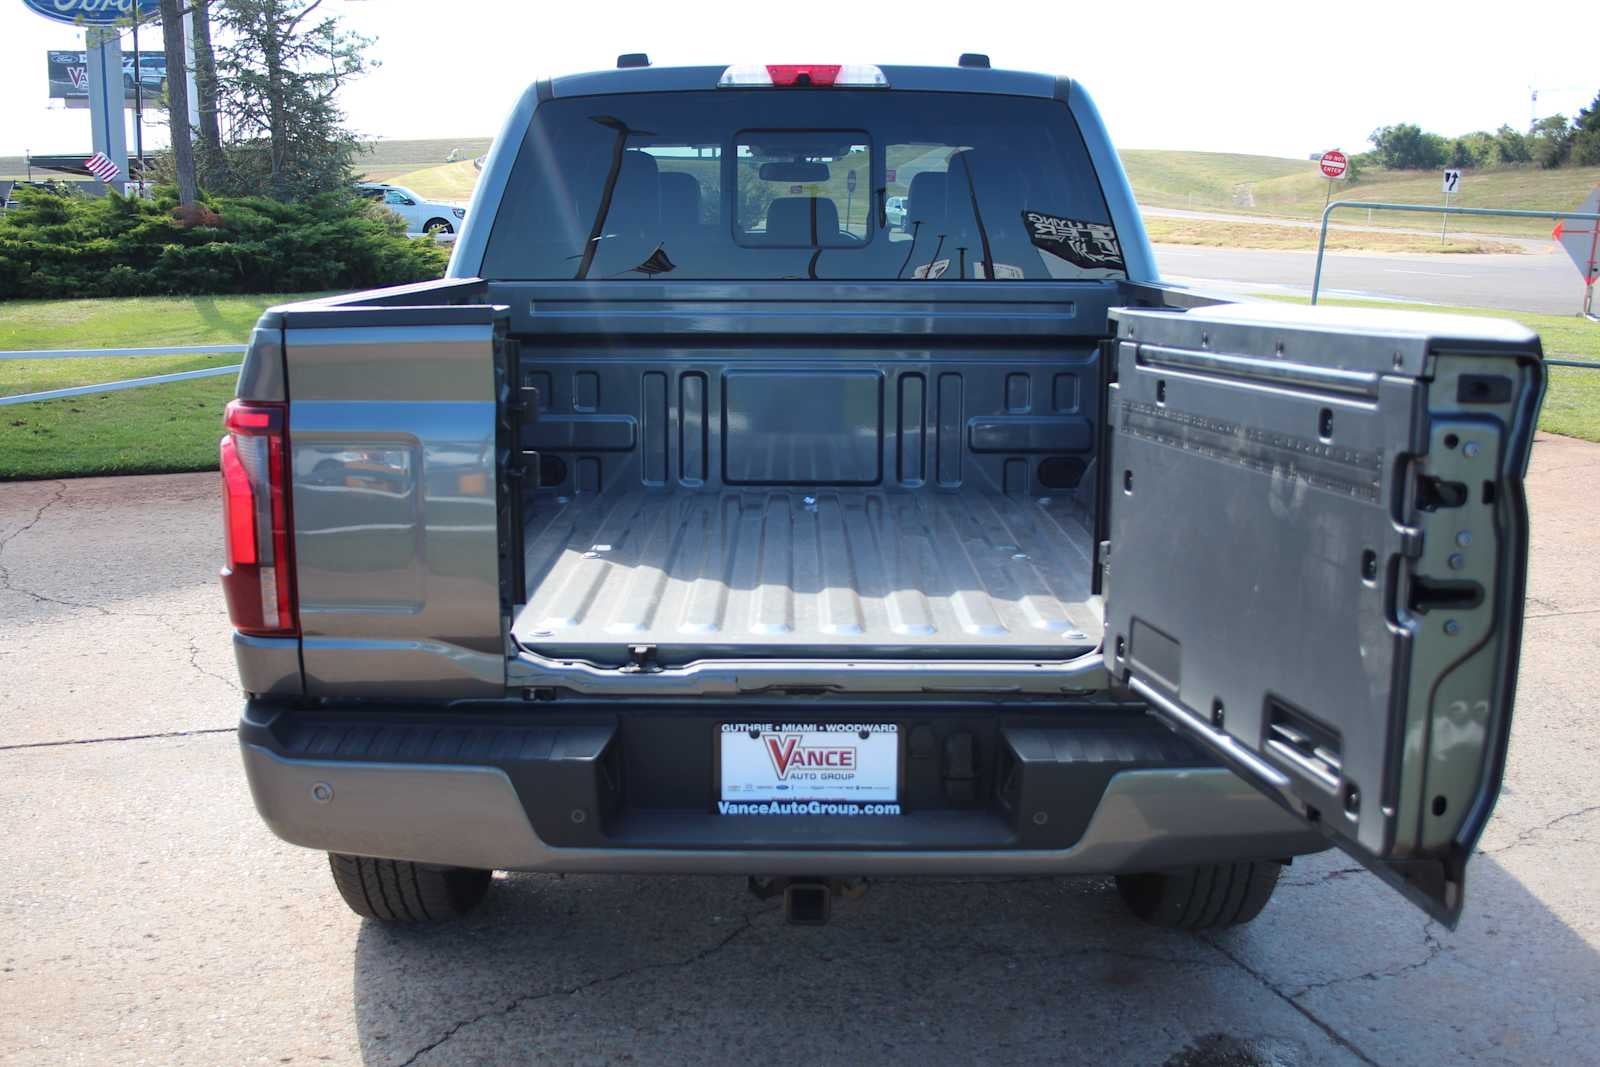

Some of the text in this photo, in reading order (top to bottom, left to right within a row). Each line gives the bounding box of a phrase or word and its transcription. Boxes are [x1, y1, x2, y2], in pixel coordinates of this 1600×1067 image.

[54, 0, 142, 11] or
[721, 724, 898, 732] GUTHRIE MIAMI WOODWARD
[764, 736, 854, 778] VANCE
[718, 801, 901, 815] VanceAutoGroup.com
